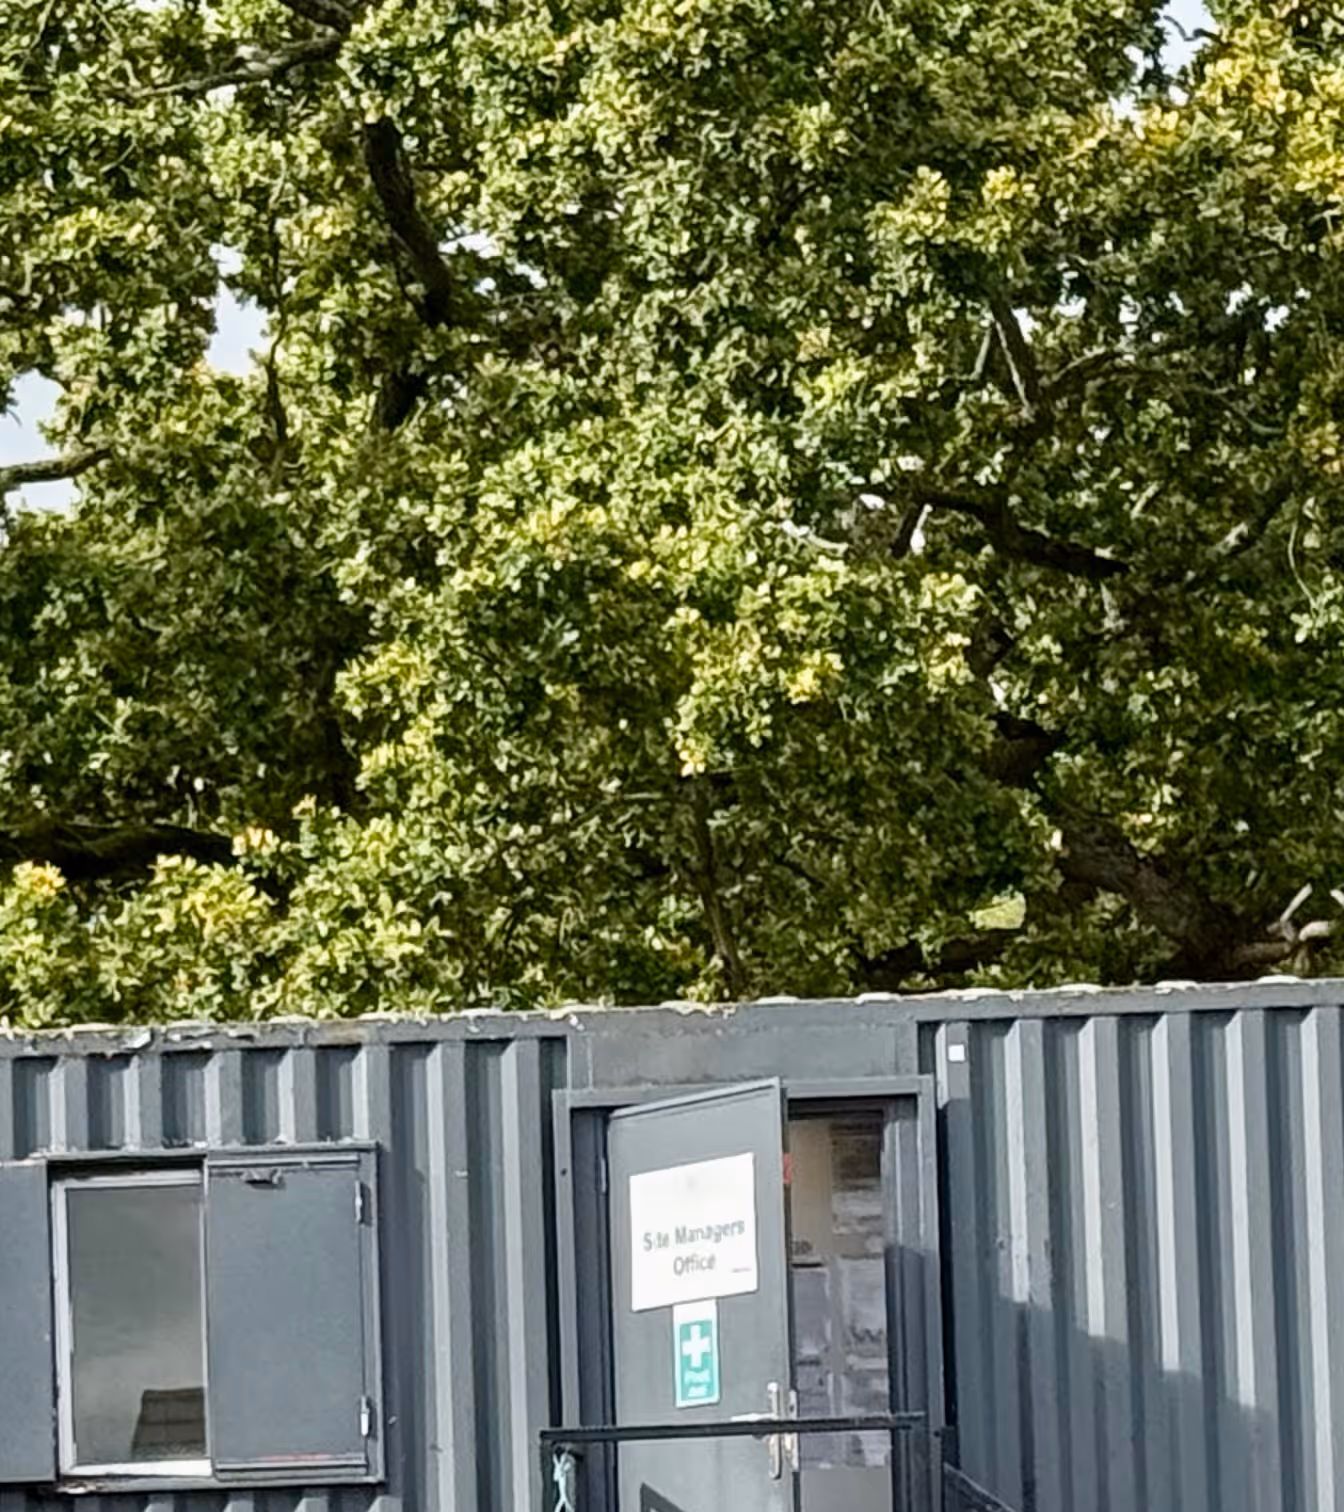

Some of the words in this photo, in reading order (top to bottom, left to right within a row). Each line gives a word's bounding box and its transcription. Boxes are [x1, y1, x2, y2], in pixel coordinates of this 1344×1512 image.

[643, 1231, 669, 1252] Ste
[674, 1219, 745, 1245] Managers
[672, 1253, 716, 1276] Office
